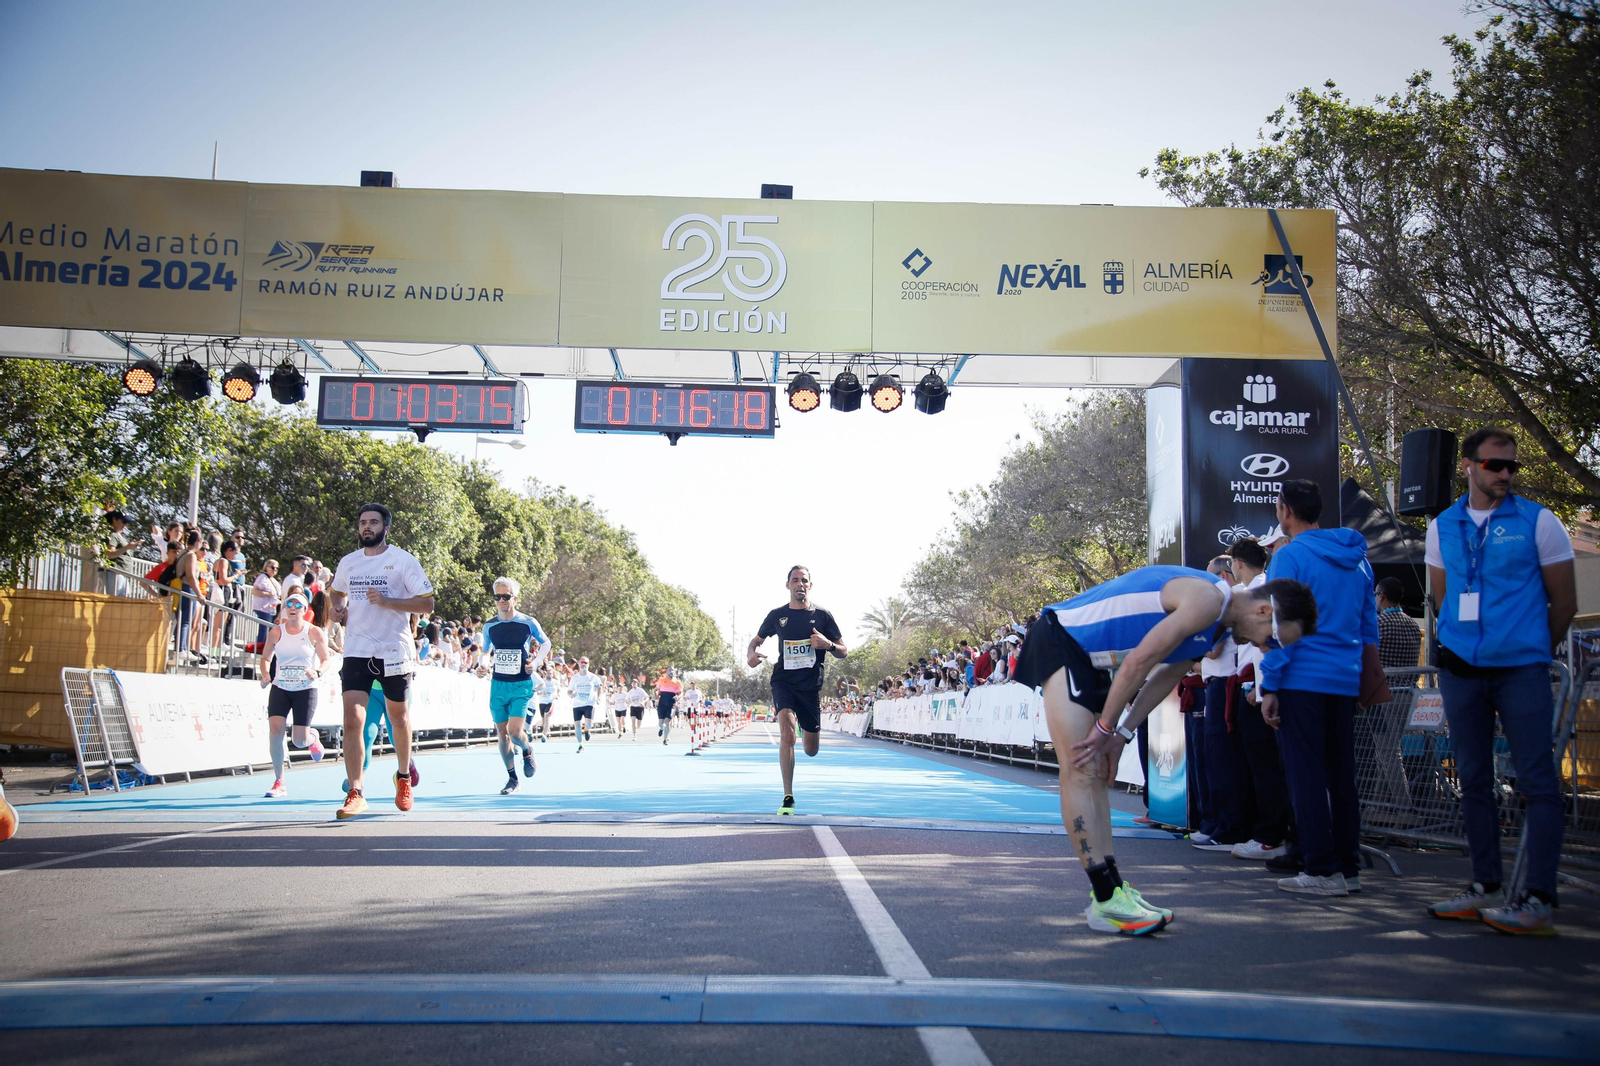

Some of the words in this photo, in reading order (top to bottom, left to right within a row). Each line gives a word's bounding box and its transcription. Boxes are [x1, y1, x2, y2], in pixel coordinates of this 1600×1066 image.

[103, 227, 239, 256] Maratón
[319, 256, 369, 266] SERIES
[661, 213, 787, 302] 25
[138, 259, 238, 291] 2024
[314, 265, 346, 273] RUTA
[349, 266, 398, 274] RUNNING
[1143, 260, 1233, 279] ALMERÍA
[258, 278, 337, 297] RAMÓN
[347, 284, 396, 299] RUIZ
[404, 283, 504, 302] ANDÚJAR
[901, 281, 979, 292] COOPERACIÓN
[1143, 281, 1189, 292] CIUDAD
[901, 291, 927, 300] 2005
[659, 305, 787, 334] EDICIÓN
[1208, 404, 1311, 432] cajamar
[1258, 426, 1280, 434] CAJA
[1281, 427, 1308, 435] RURAL
[1230, 481, 1283, 492] HYUND
[786, 644, 812, 655] 1507
[496, 654, 519, 662] 5052
[1412, 711, 1441, 722] EVENTOS
